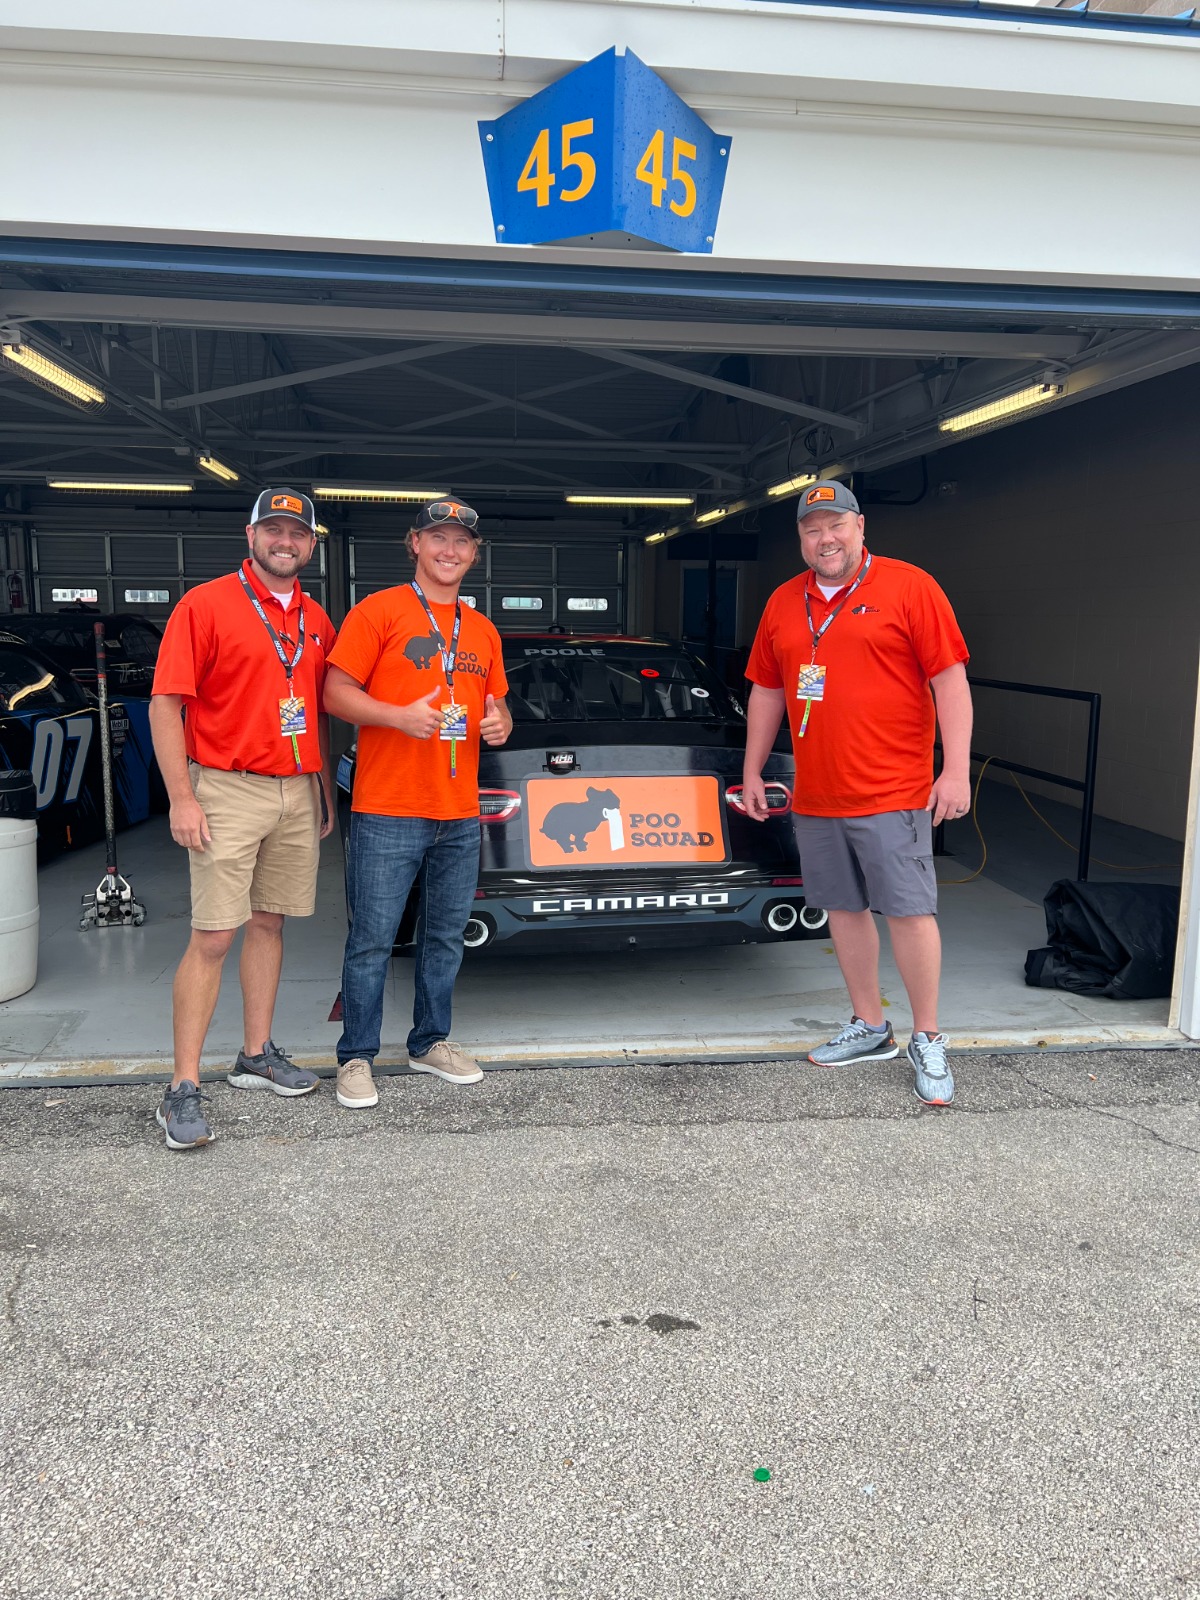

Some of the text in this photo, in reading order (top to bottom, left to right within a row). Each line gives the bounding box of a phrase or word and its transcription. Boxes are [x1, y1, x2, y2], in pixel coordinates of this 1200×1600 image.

[517, 117, 597, 208] 45
[635, 128, 697, 218] 45
[523, 648, 606, 656] POOLE
[31, 717, 93, 810] 07
[550, 754, 574, 764] MHR
[629, 813, 681, 828] POO
[630, 831, 715, 848] SQUAD
[532, 892, 729, 913] CAMARO
